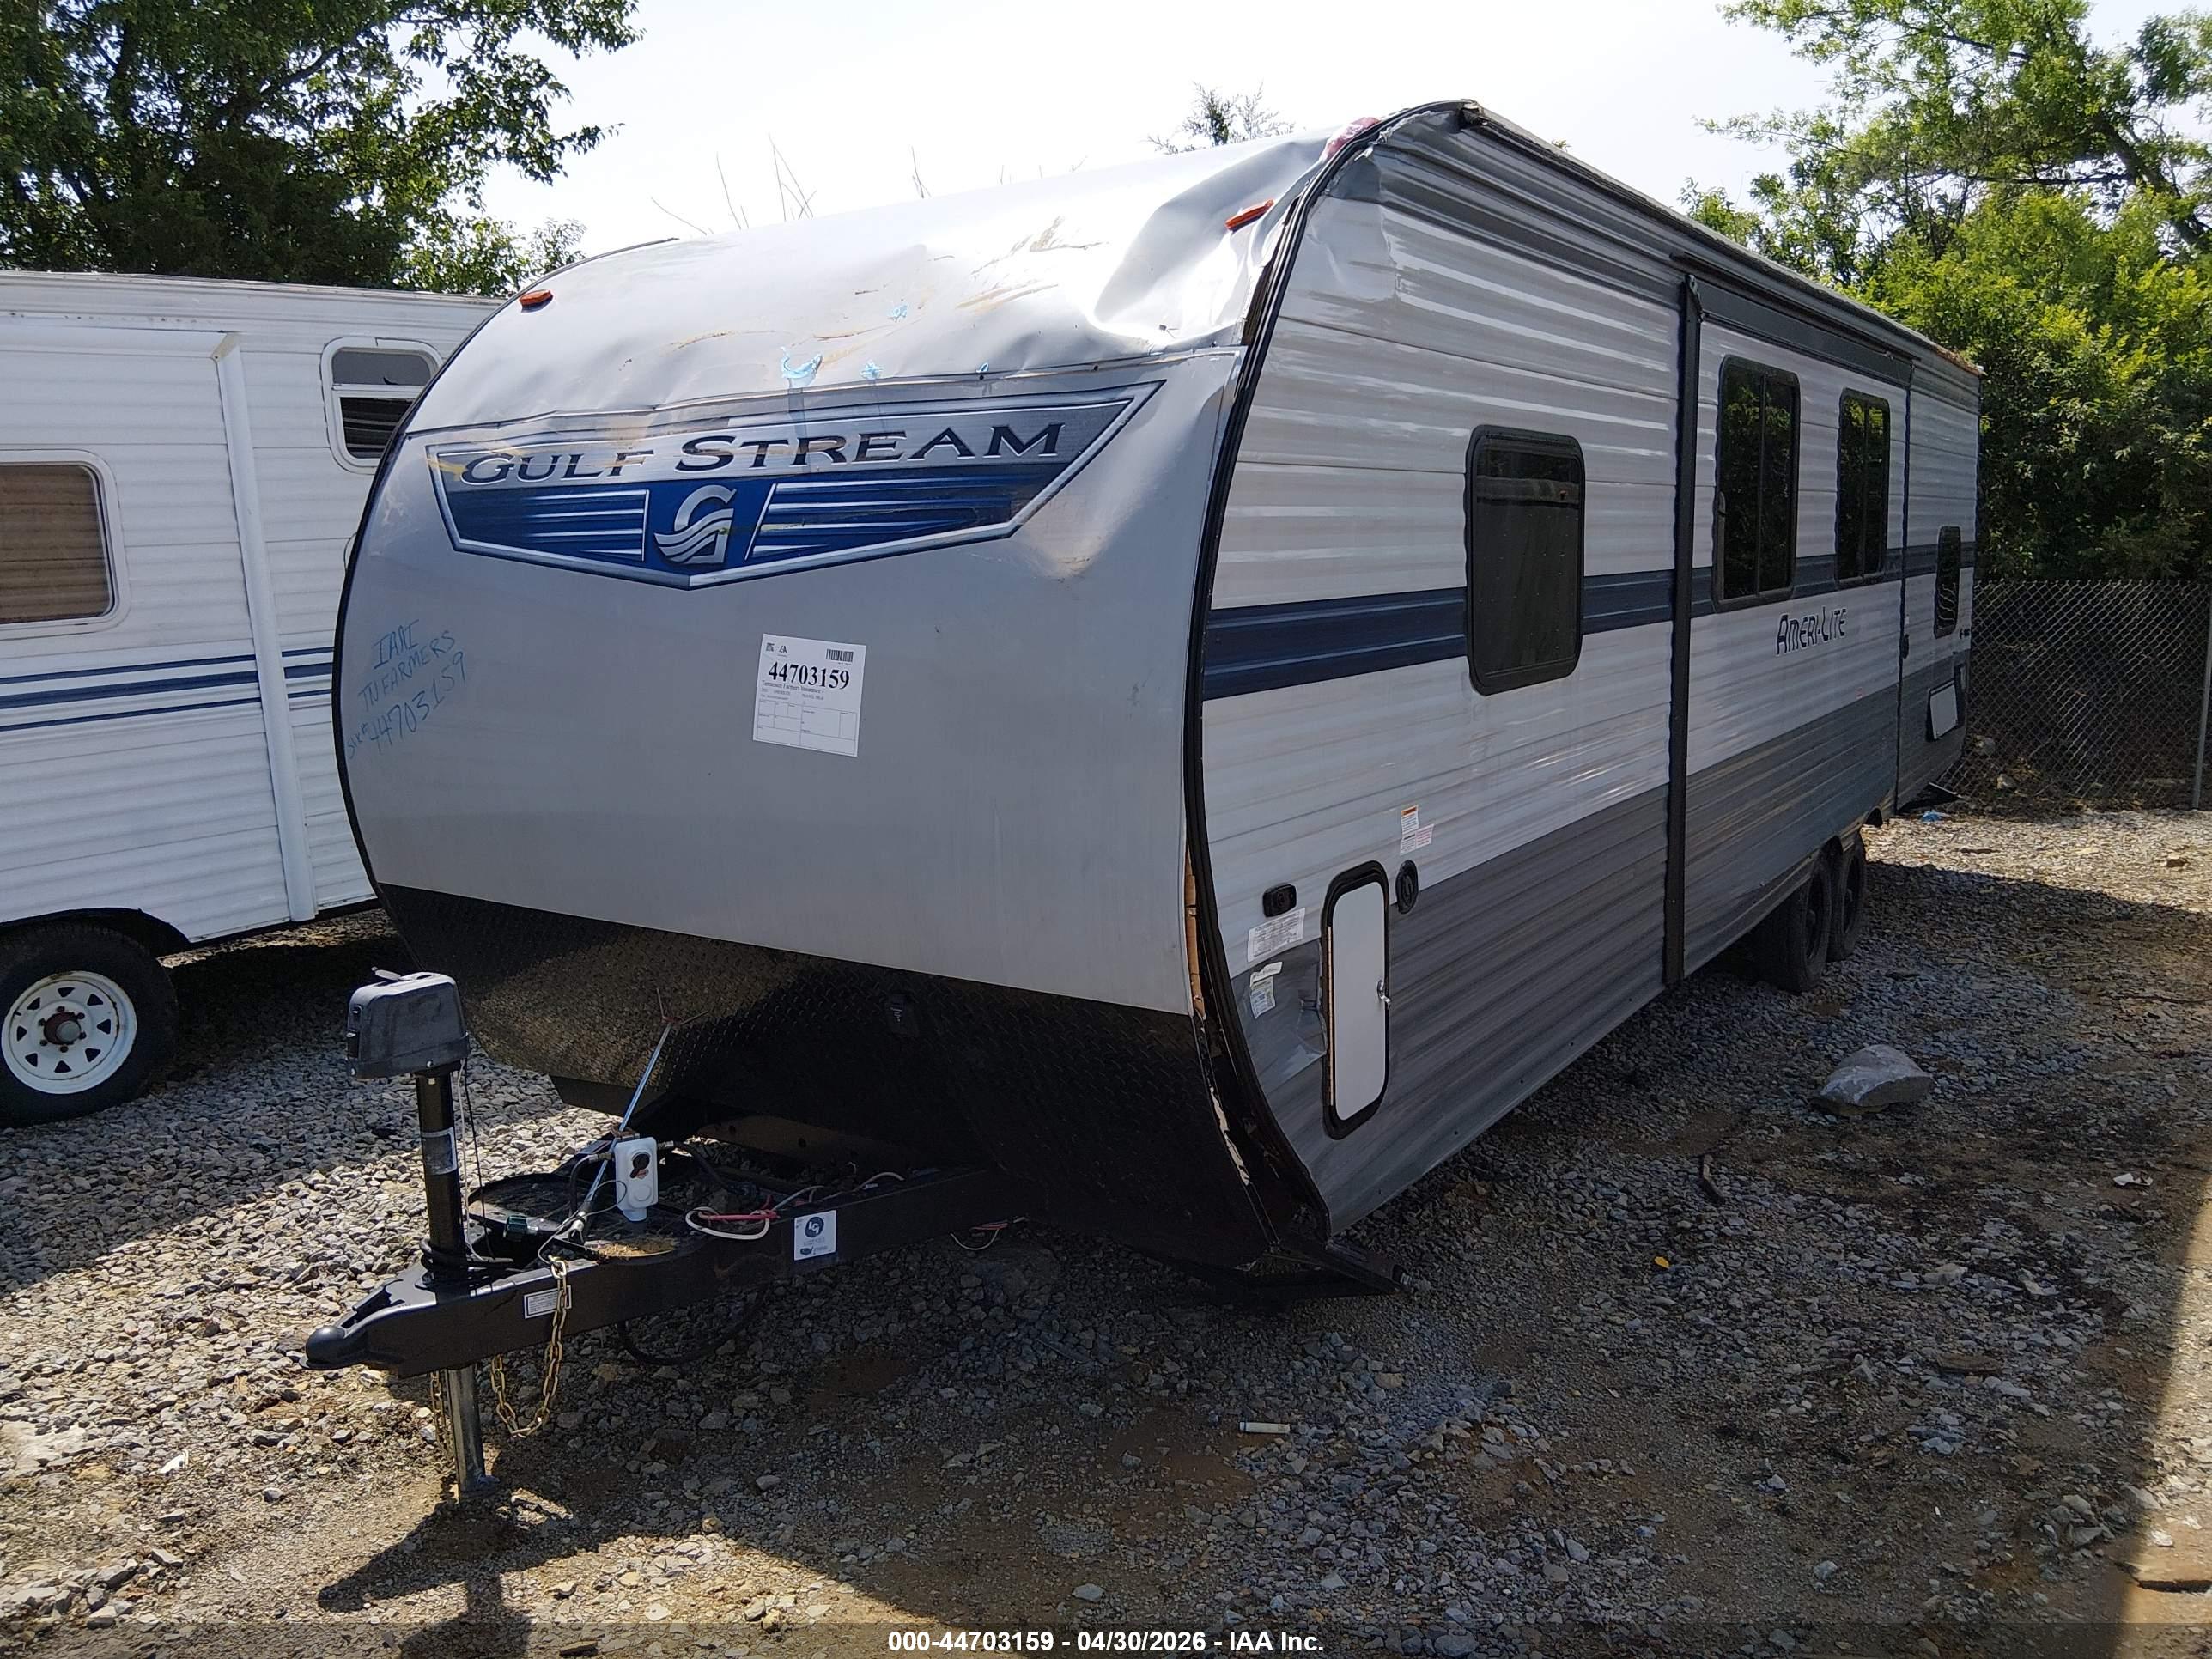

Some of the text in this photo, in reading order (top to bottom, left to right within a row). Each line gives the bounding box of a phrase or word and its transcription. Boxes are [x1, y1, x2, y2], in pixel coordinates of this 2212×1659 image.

[460, 423, 1066, 485] GULF STREAM
[769, 661, 850, 690] 44703159
